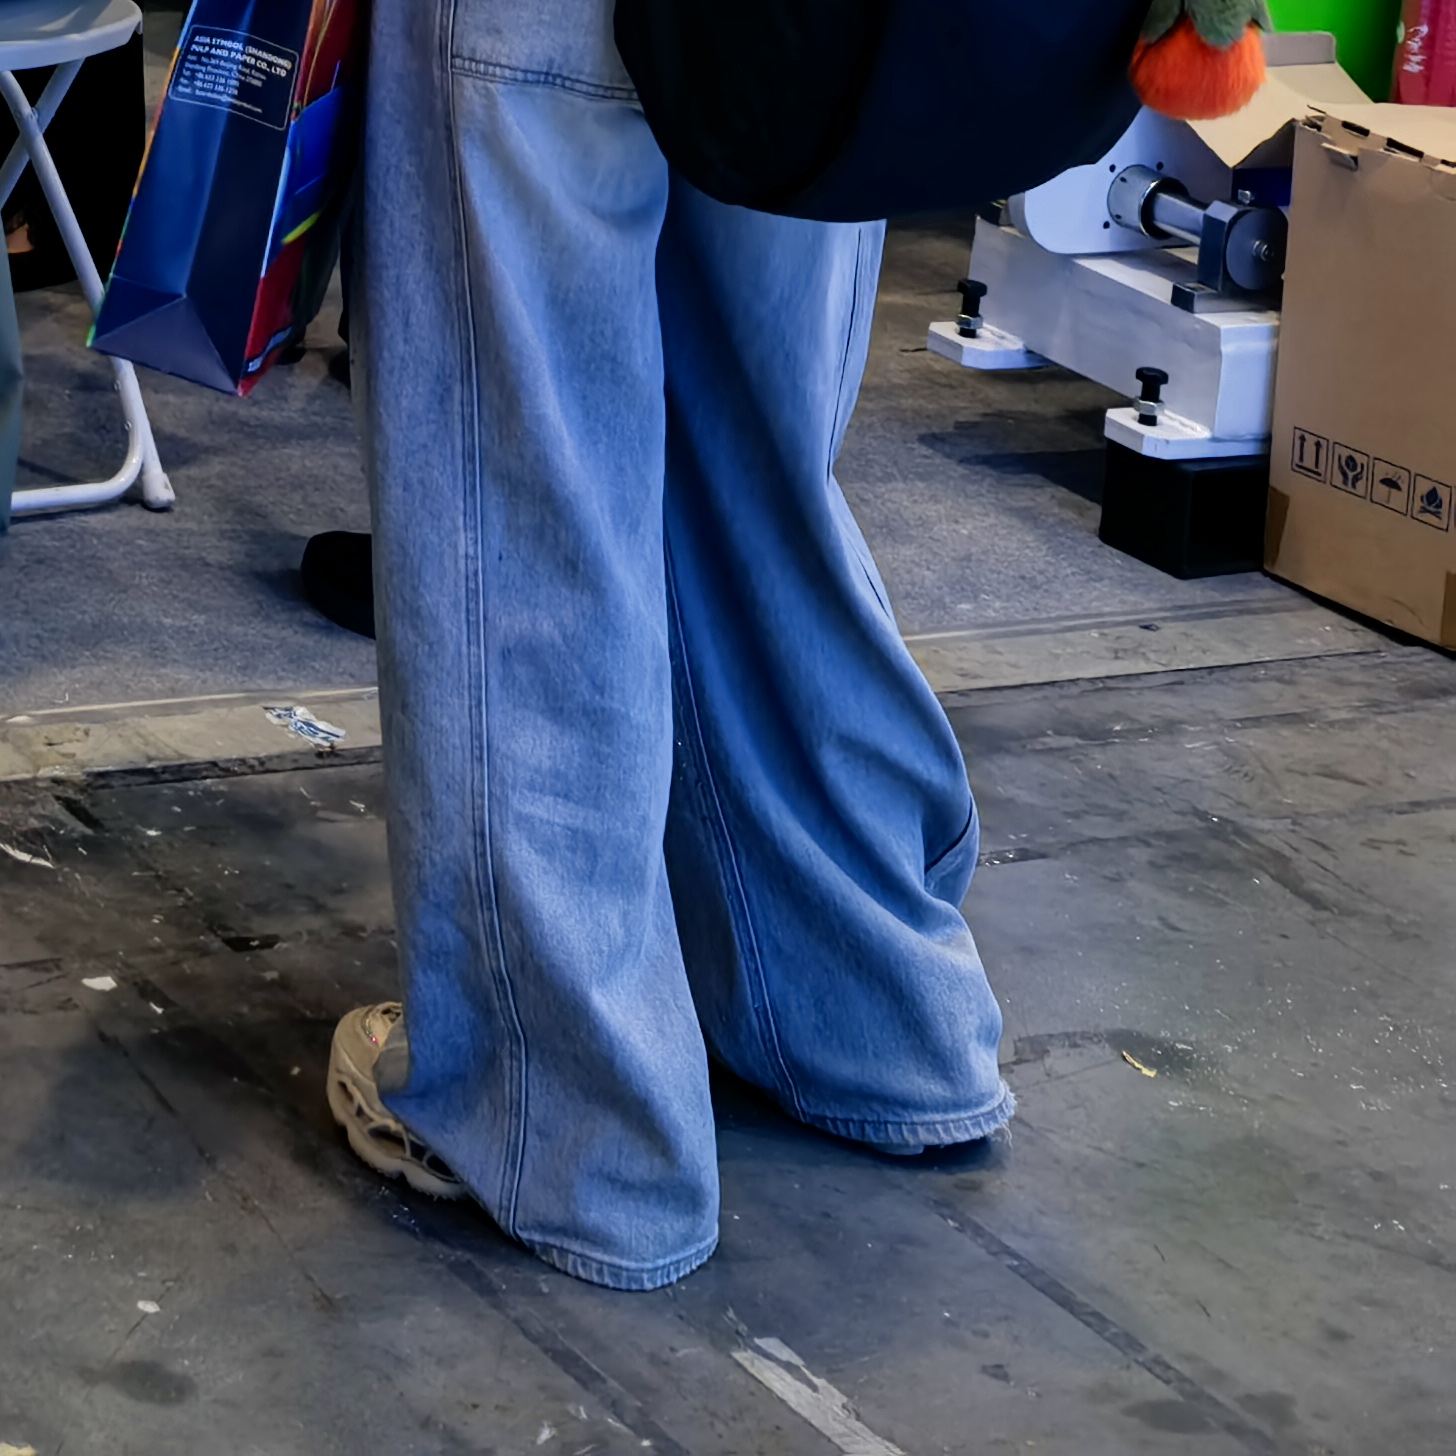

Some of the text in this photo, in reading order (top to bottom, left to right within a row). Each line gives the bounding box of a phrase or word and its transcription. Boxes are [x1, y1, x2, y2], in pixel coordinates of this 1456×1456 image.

[210, 46, 228, 57] AND
[230, 49, 255, 66] PAPER
[272, 65, 287, 77] LTD
